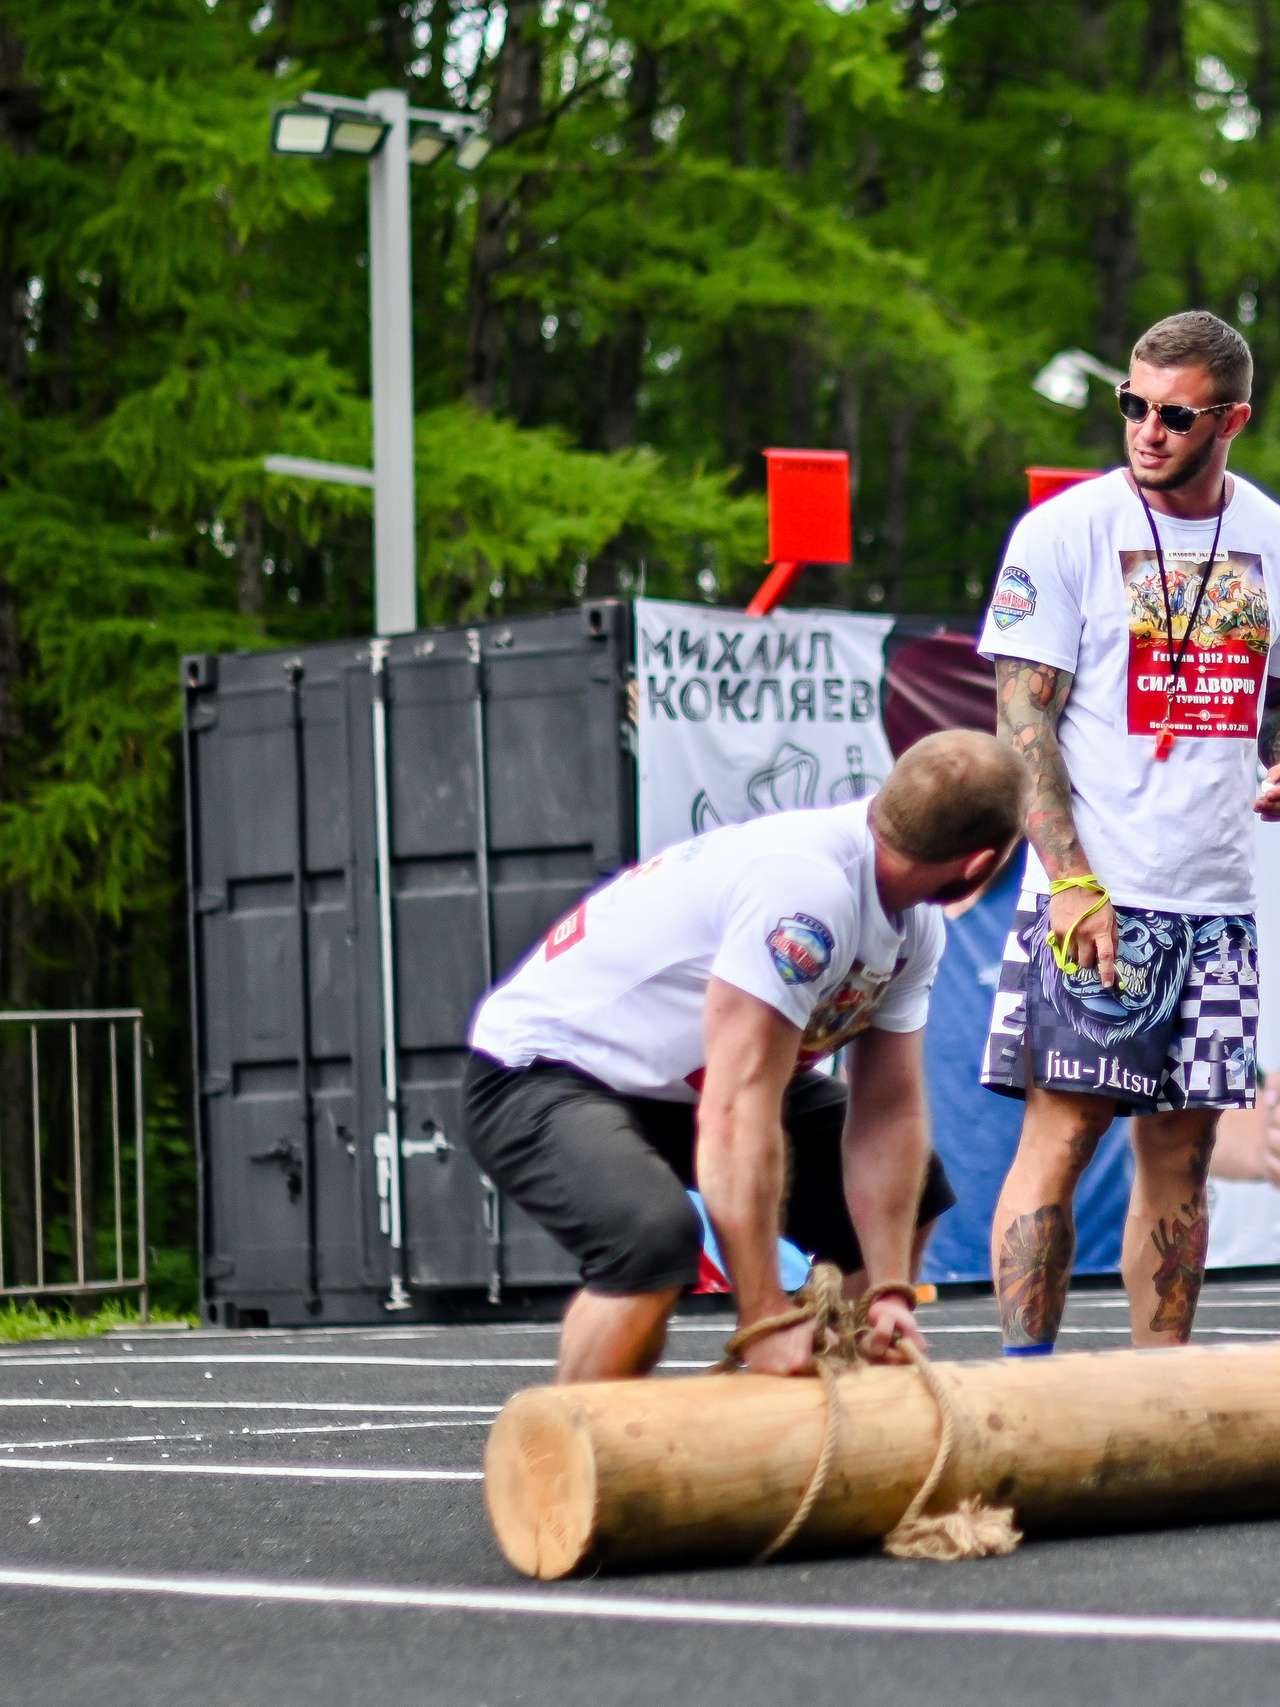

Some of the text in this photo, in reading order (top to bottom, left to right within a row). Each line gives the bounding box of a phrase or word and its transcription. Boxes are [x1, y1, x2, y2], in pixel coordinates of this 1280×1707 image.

[641, 628, 836, 674] МИХАИЛ
[1198, 652, 1224, 664] 1812
[1195, 677, 1256, 695] ДВОРОВ
[647, 674, 877, 723] КОКЛЯЕВ
[1176, 695, 1212, 704] ТУРНИР
[1222, 696, 1235, 705] 26
